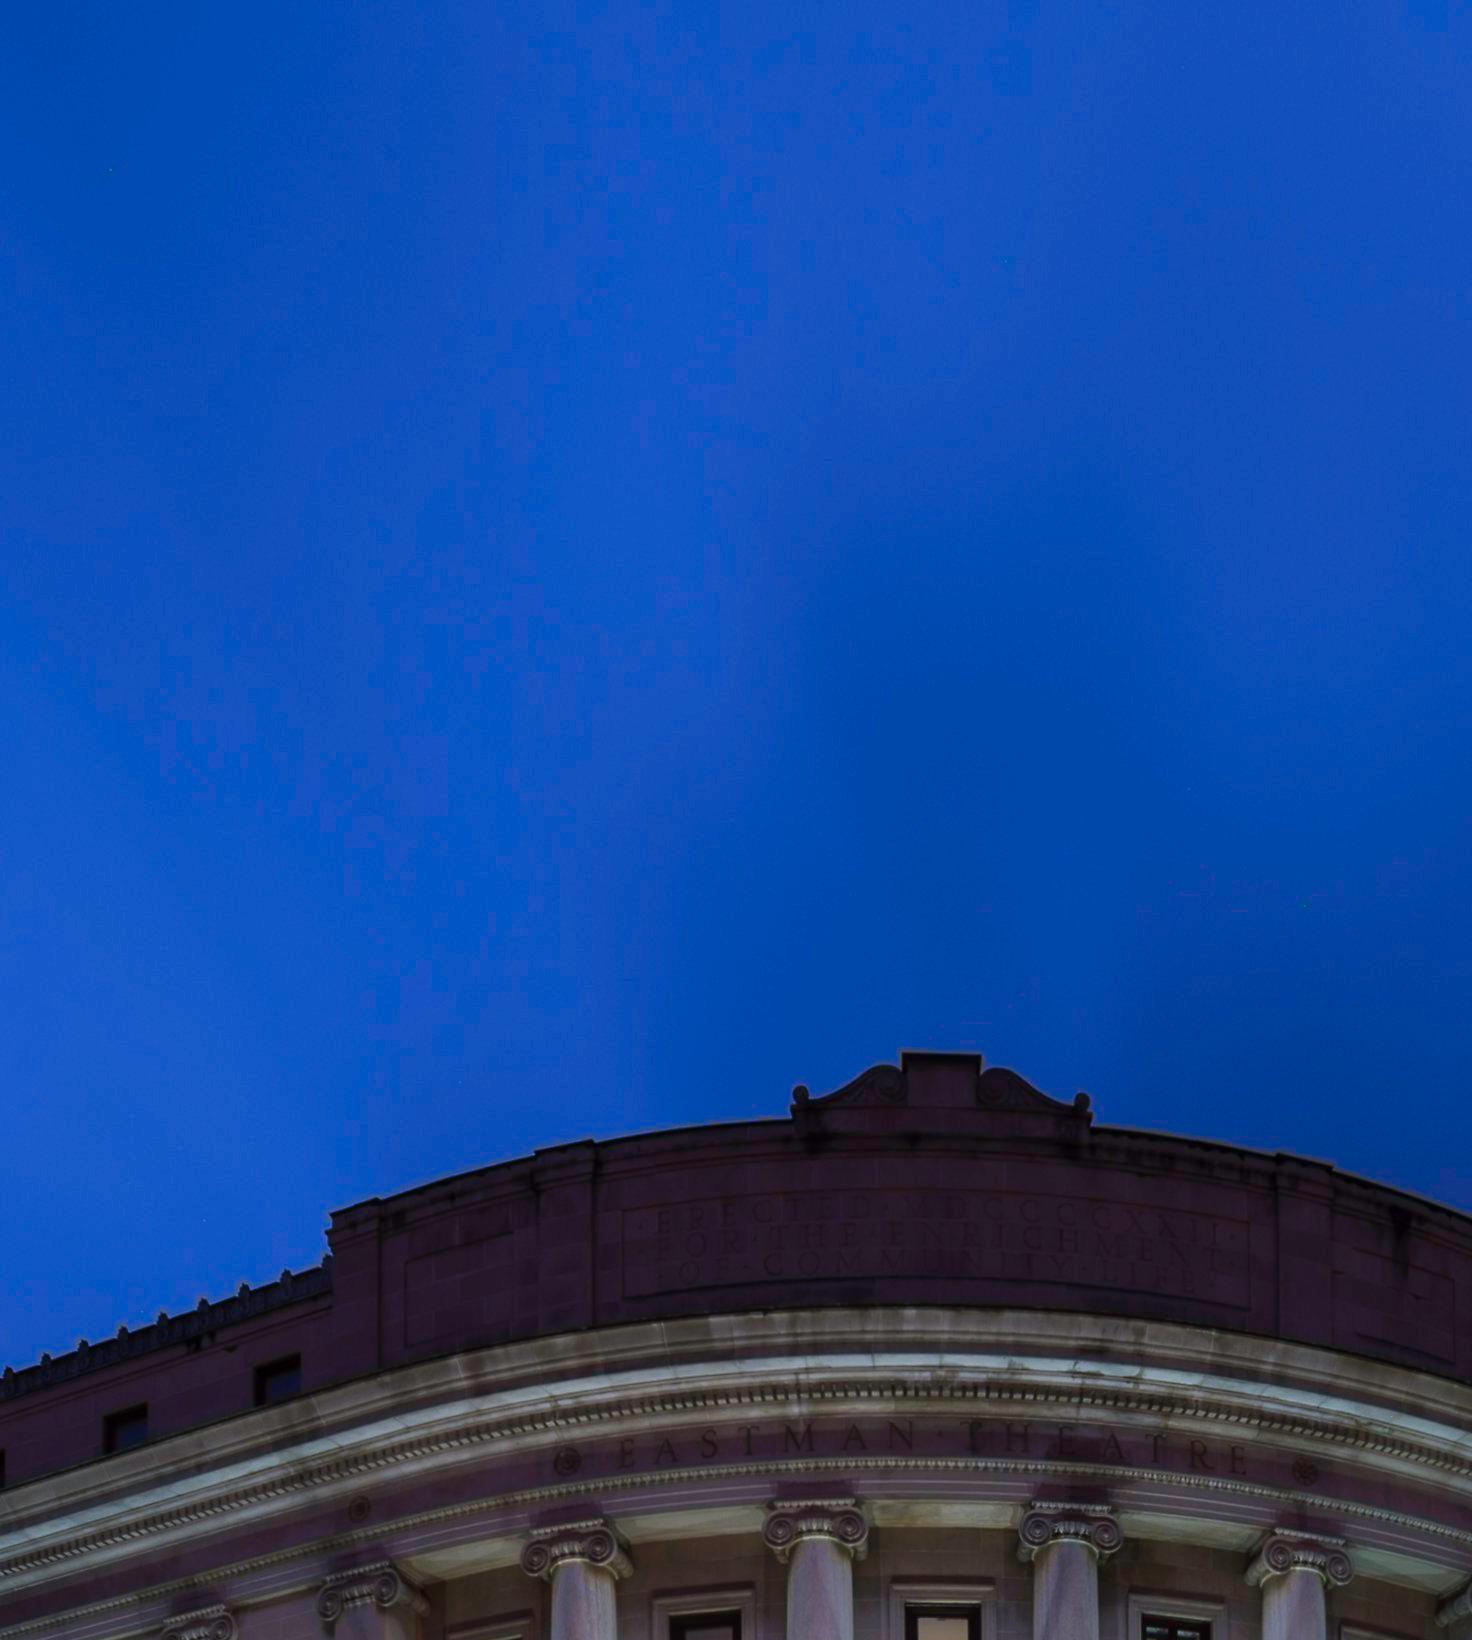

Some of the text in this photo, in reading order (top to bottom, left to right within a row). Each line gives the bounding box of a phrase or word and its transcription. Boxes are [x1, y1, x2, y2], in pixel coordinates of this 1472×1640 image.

[657, 1194, 871, 1234] ERECTED
[655, 1221, 1222, 1272] FOR THE ENRICHMENT
[679, 1248, 1199, 1294] OF COMMUNITY LIFE
[616, 1417, 1247, 1476] EASTMAN THEATRE
